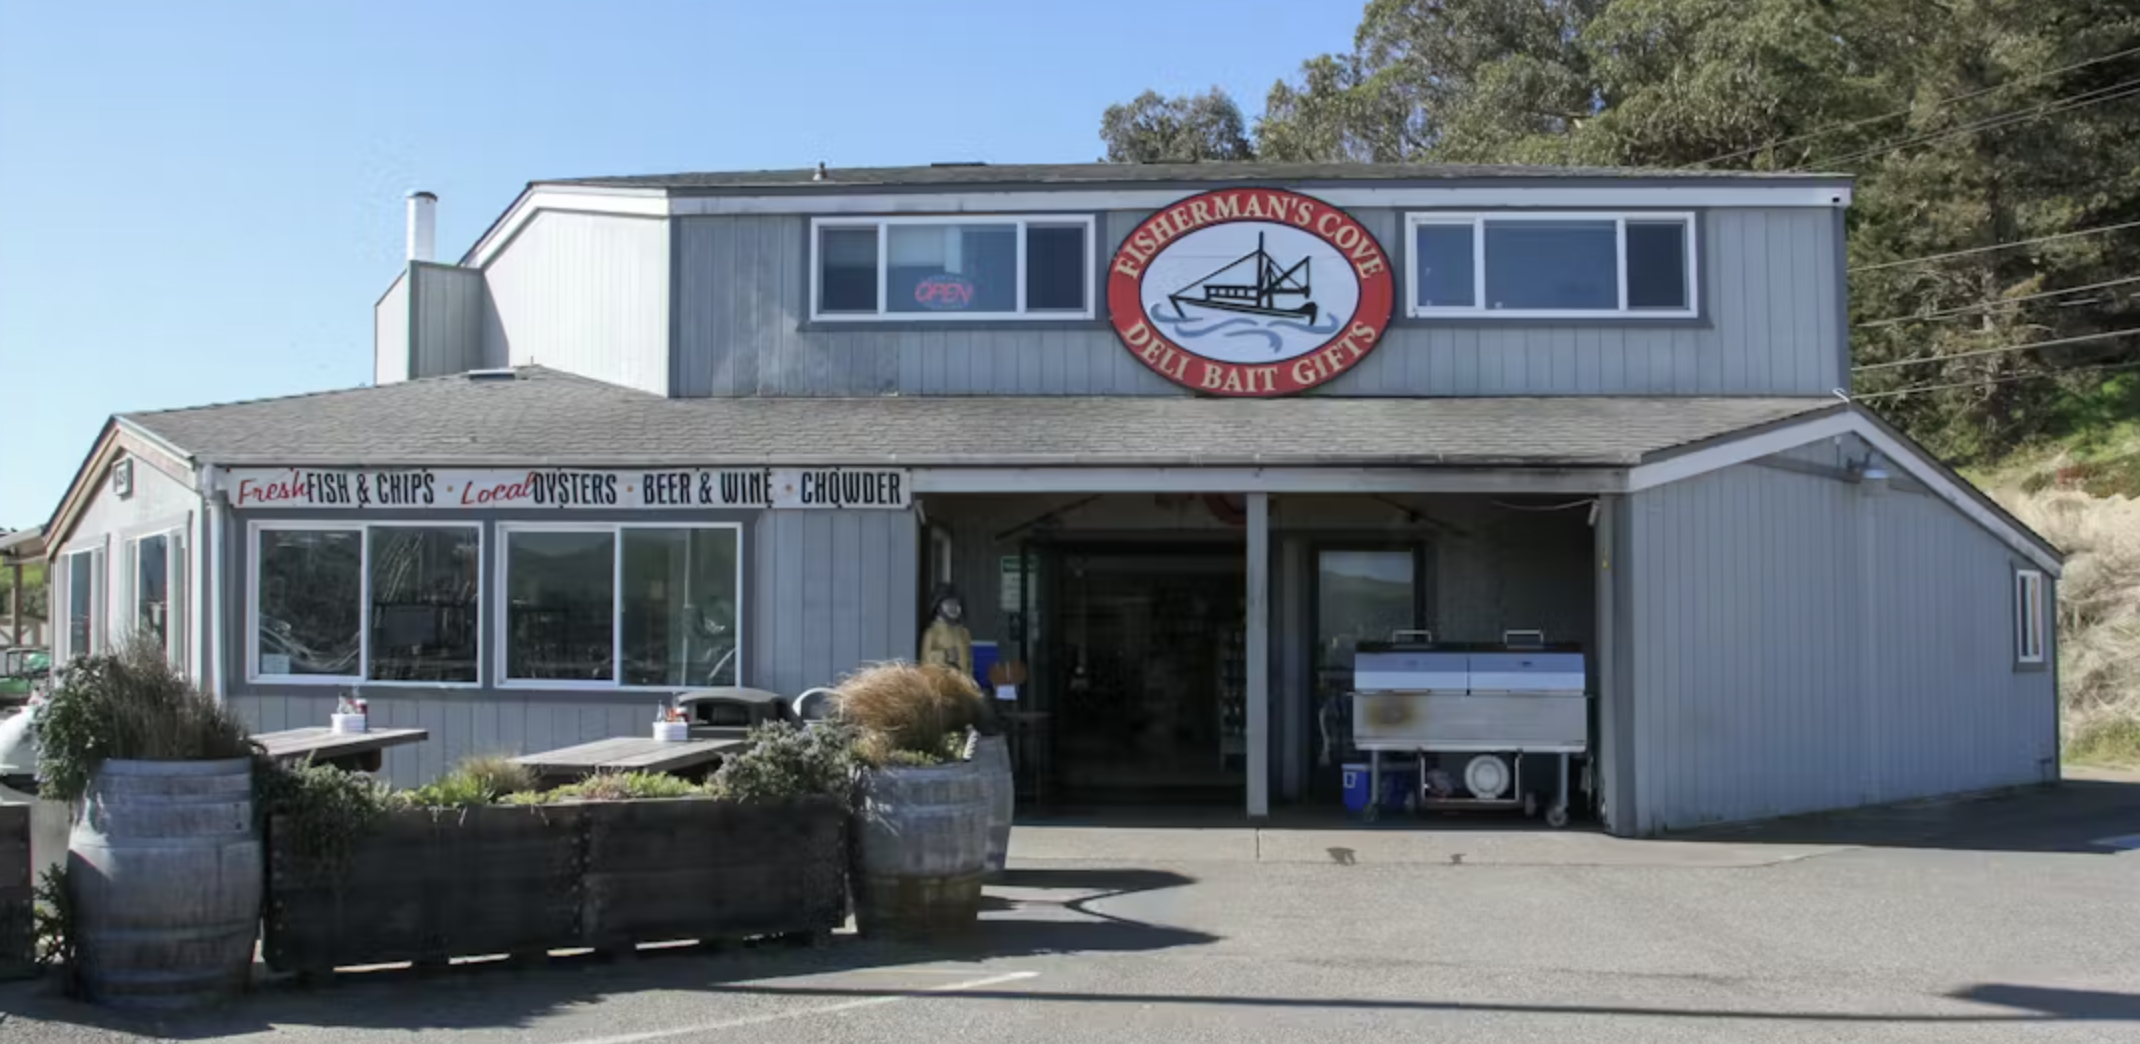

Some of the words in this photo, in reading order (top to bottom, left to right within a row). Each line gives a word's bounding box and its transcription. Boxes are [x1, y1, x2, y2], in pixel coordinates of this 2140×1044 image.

[1115, 193, 1313, 279] FISHERMAN'S
[1317, 212, 1384, 279] COVE
[914, 281, 973, 304] OPEN
[1122, 319, 1191, 381] DELI
[1201, 363, 1278, 393] BAIT
[1291, 321, 1376, 386] GIFTS
[238, 470, 308, 504] Fresh
[306, 472, 349, 504] FISH
[356, 472, 371, 504] &
[377, 472, 434, 504] CHIPS
[461, 471, 535, 505] Local
[533, 472, 617, 504] OYSTERS
[643, 473, 692, 504] BEER
[699, 473, 714, 504] &
[721, 471, 774, 504] WINE
[801, 471, 902, 505] CHOWDER
